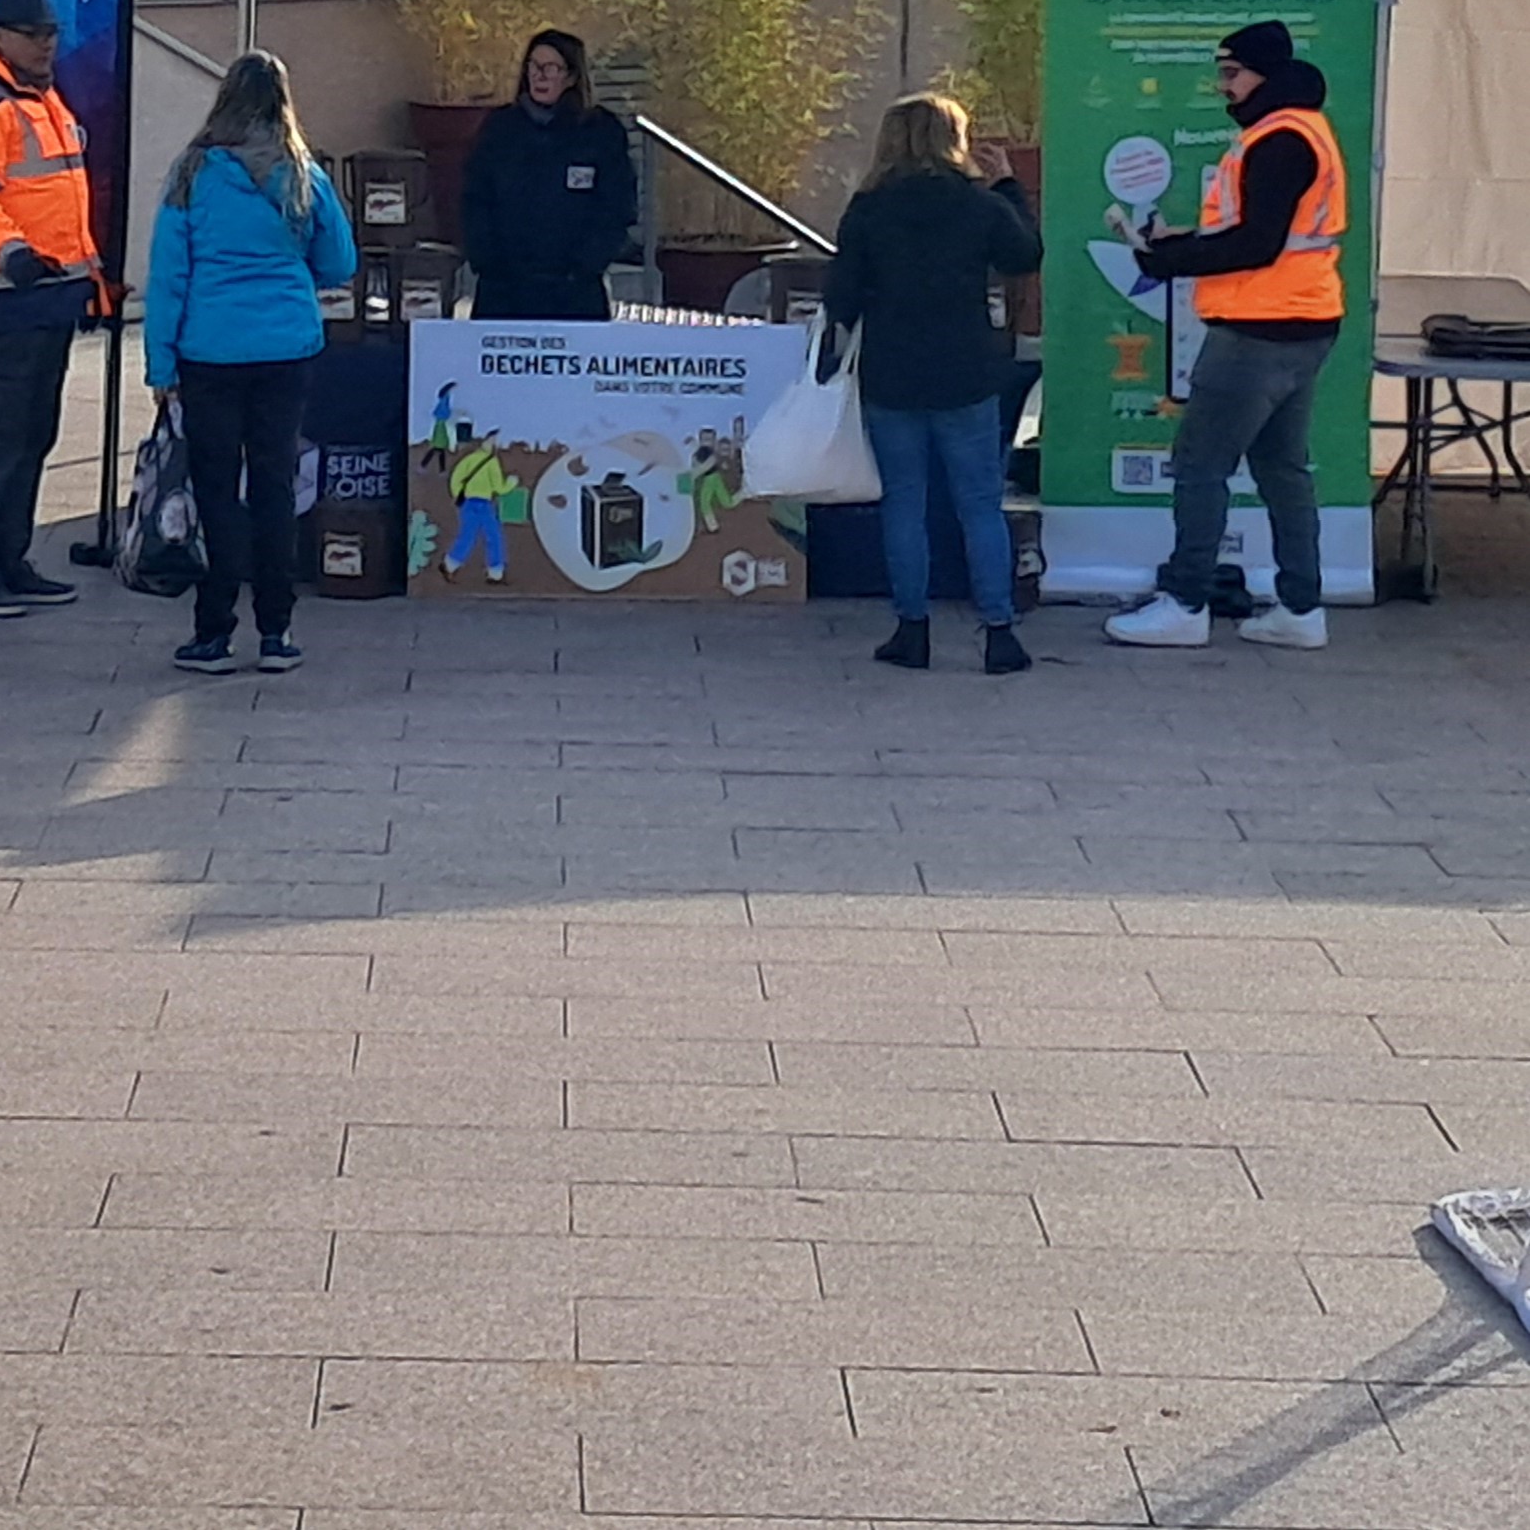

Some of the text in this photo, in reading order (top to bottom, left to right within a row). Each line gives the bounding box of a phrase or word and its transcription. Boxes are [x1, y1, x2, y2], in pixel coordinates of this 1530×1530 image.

[480, 335, 566, 350] GESTION DES
[586, 356, 747, 379] ALIMENTAIRES
[594, 380, 746, 396] DANS VOTRE COMMUNE
[326, 452, 391, 476] SEINE
